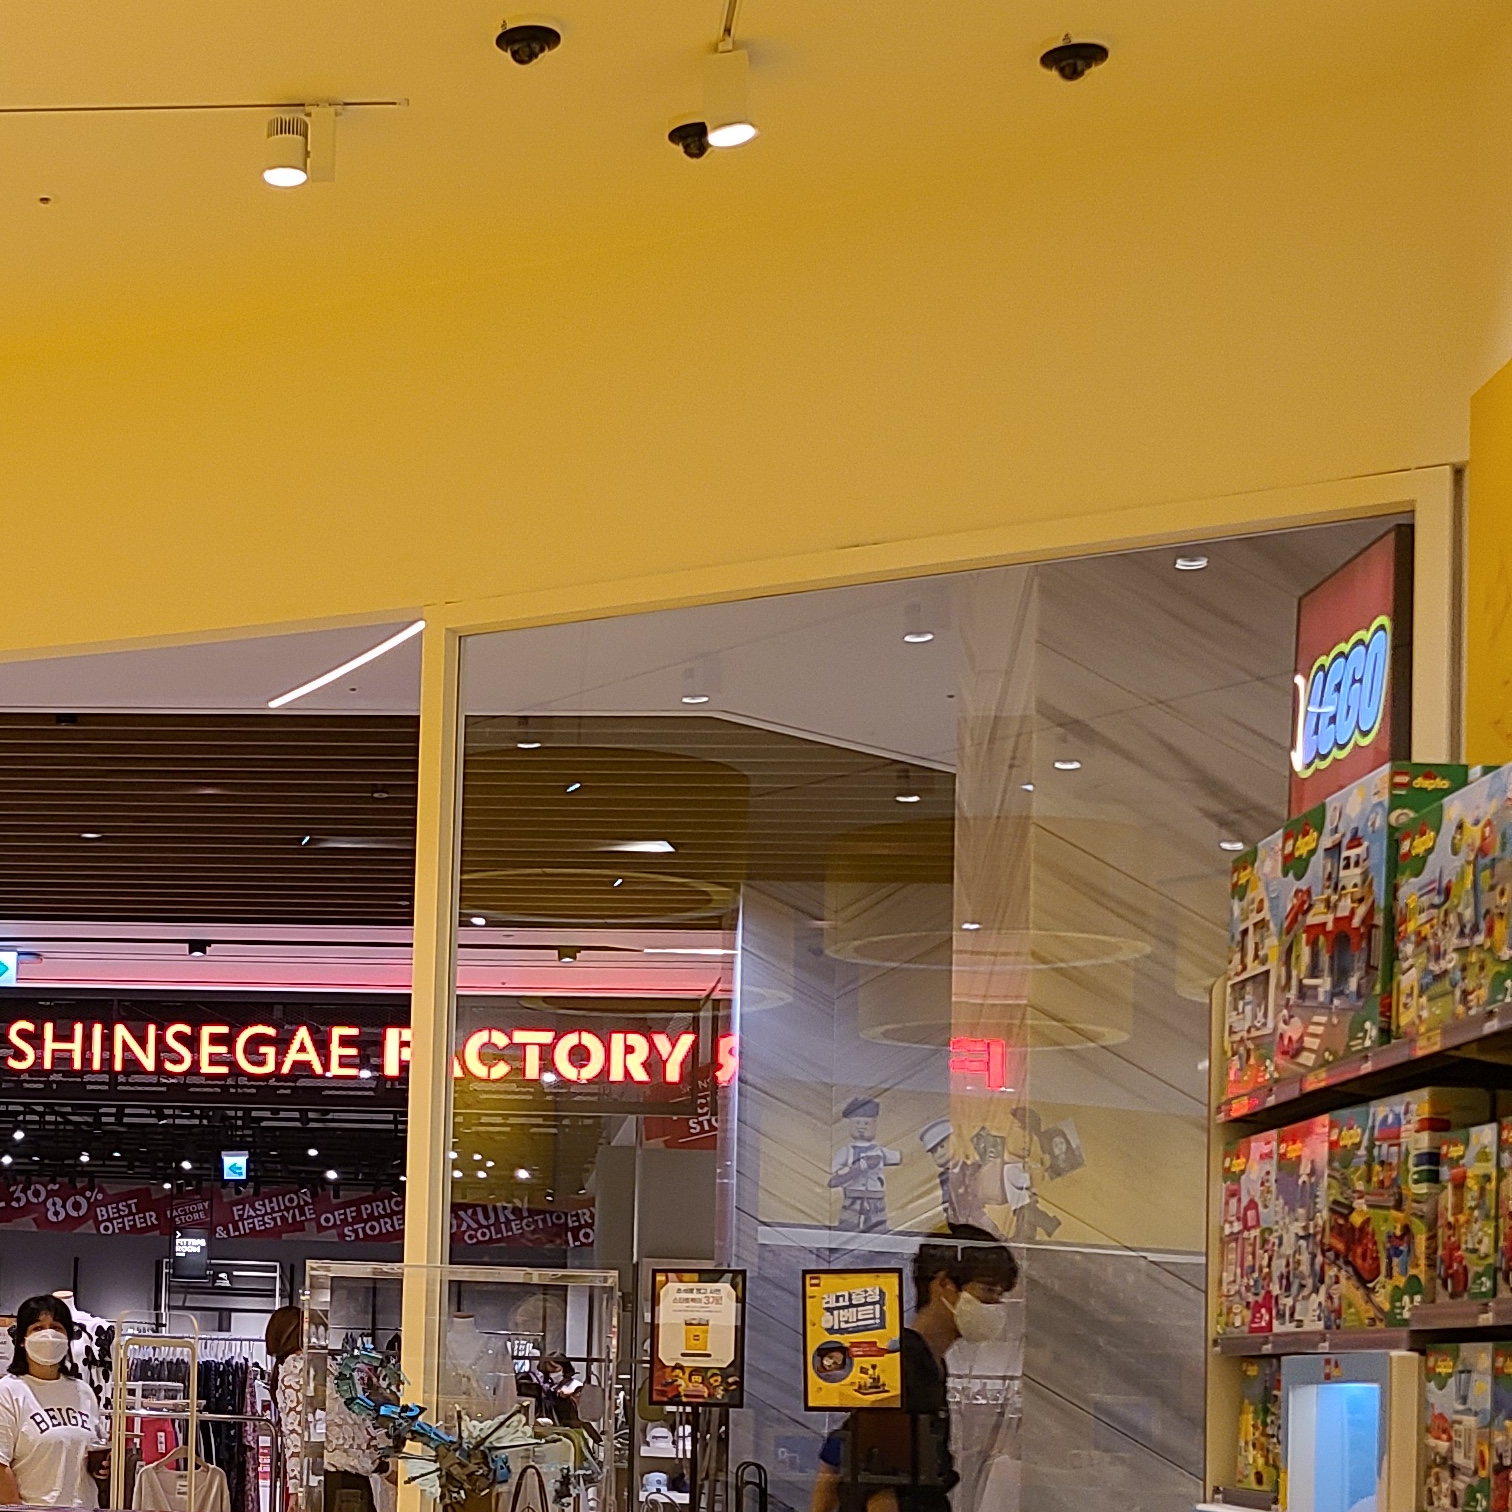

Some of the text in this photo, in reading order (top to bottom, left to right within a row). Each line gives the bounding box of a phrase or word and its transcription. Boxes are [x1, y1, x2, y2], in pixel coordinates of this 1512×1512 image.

[1302, 628, 1388, 765] LEGO
[5, 1019, 361, 1077] SHINSEGAE
[46, 1187, 104, 1222] 80%
[96, 1199, 139, 1221] BEST
[175, 1211, 207, 1225] STORE
[232, 1191, 313, 1221] FASHION
[319, 1205, 358, 1228] OFF
[99, 1211, 159, 1235] OFFER
[343, 1215, 404, 1241] STORE
[821, 1303, 881, 1330] 이벤트!
[29, 1406, 92, 1435] BEIGE
